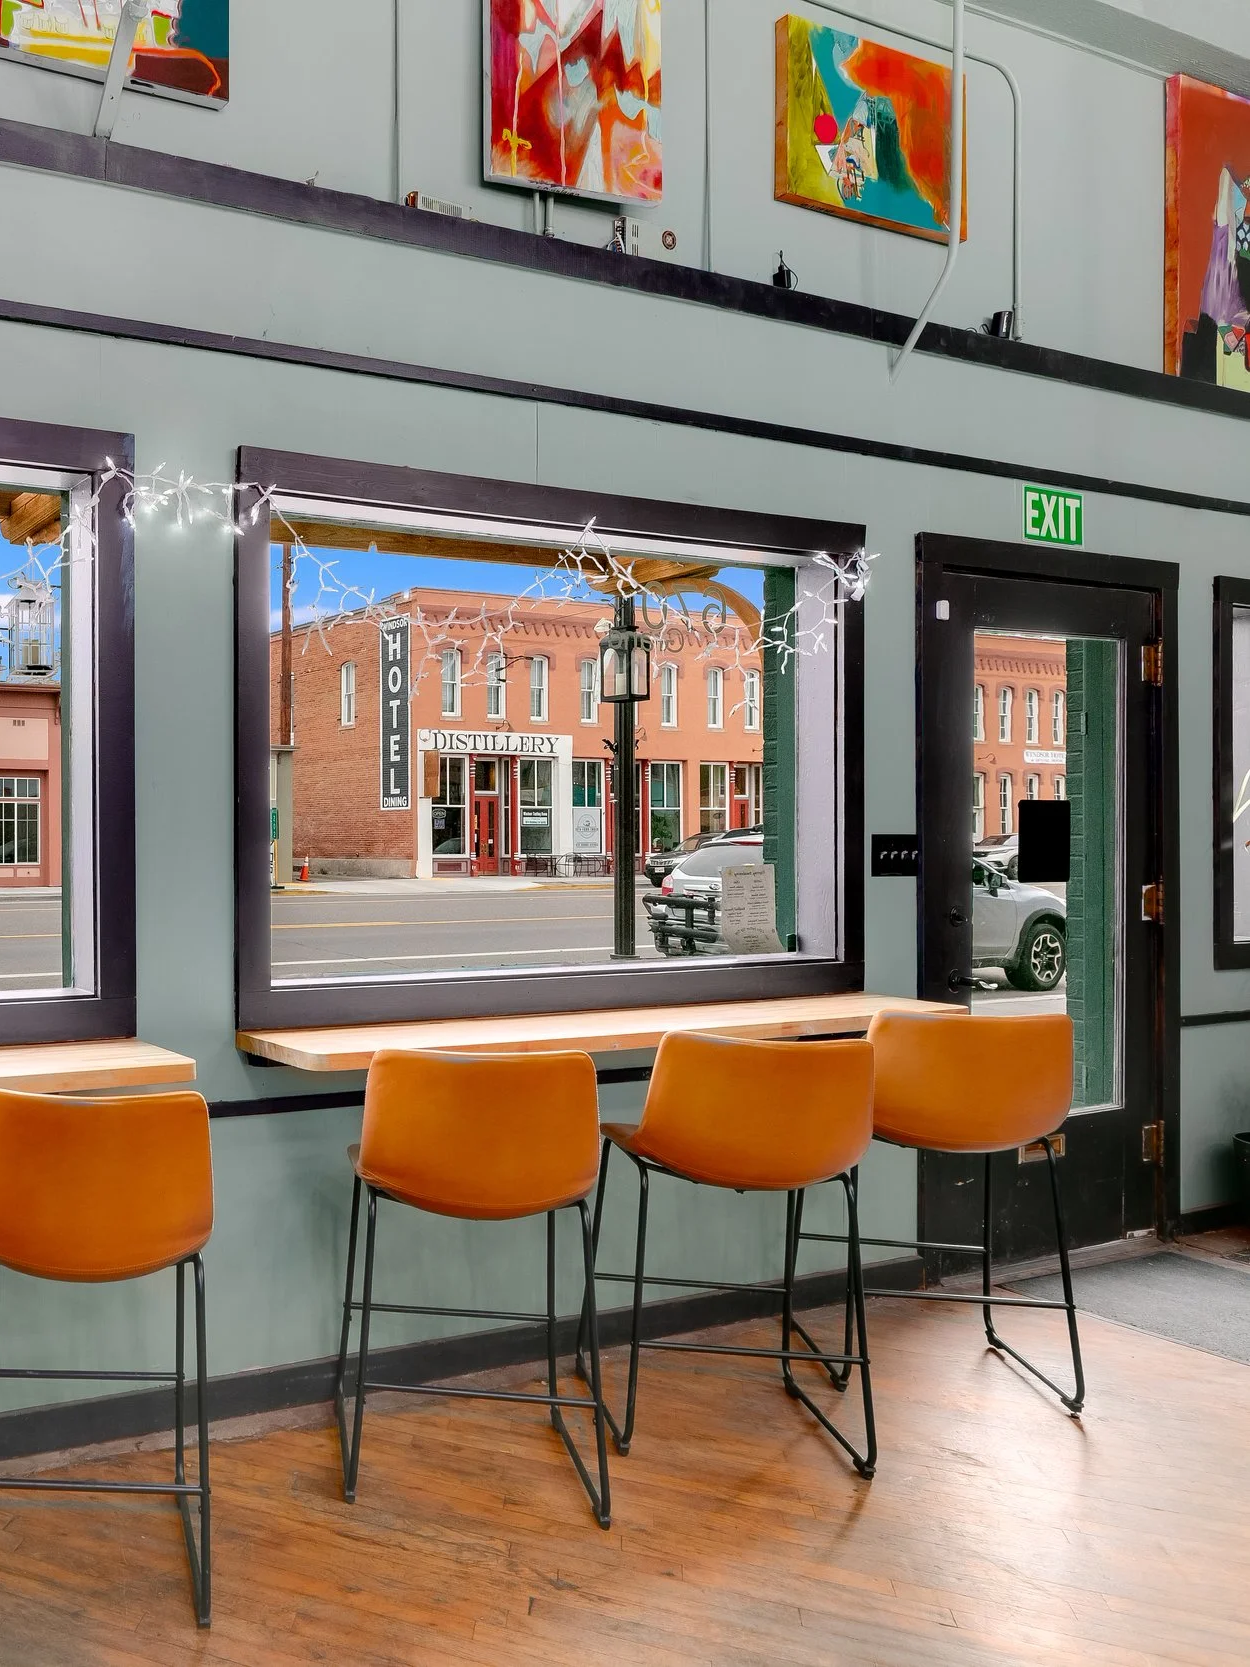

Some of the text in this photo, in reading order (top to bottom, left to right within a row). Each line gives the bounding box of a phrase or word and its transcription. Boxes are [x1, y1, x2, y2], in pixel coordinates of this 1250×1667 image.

[1026, 491, 1080, 541] EXIT
[387, 632, 402, 795] HOTEL
[432, 732, 560, 754] DISTILLERY
[383, 796, 407, 807] DINING
